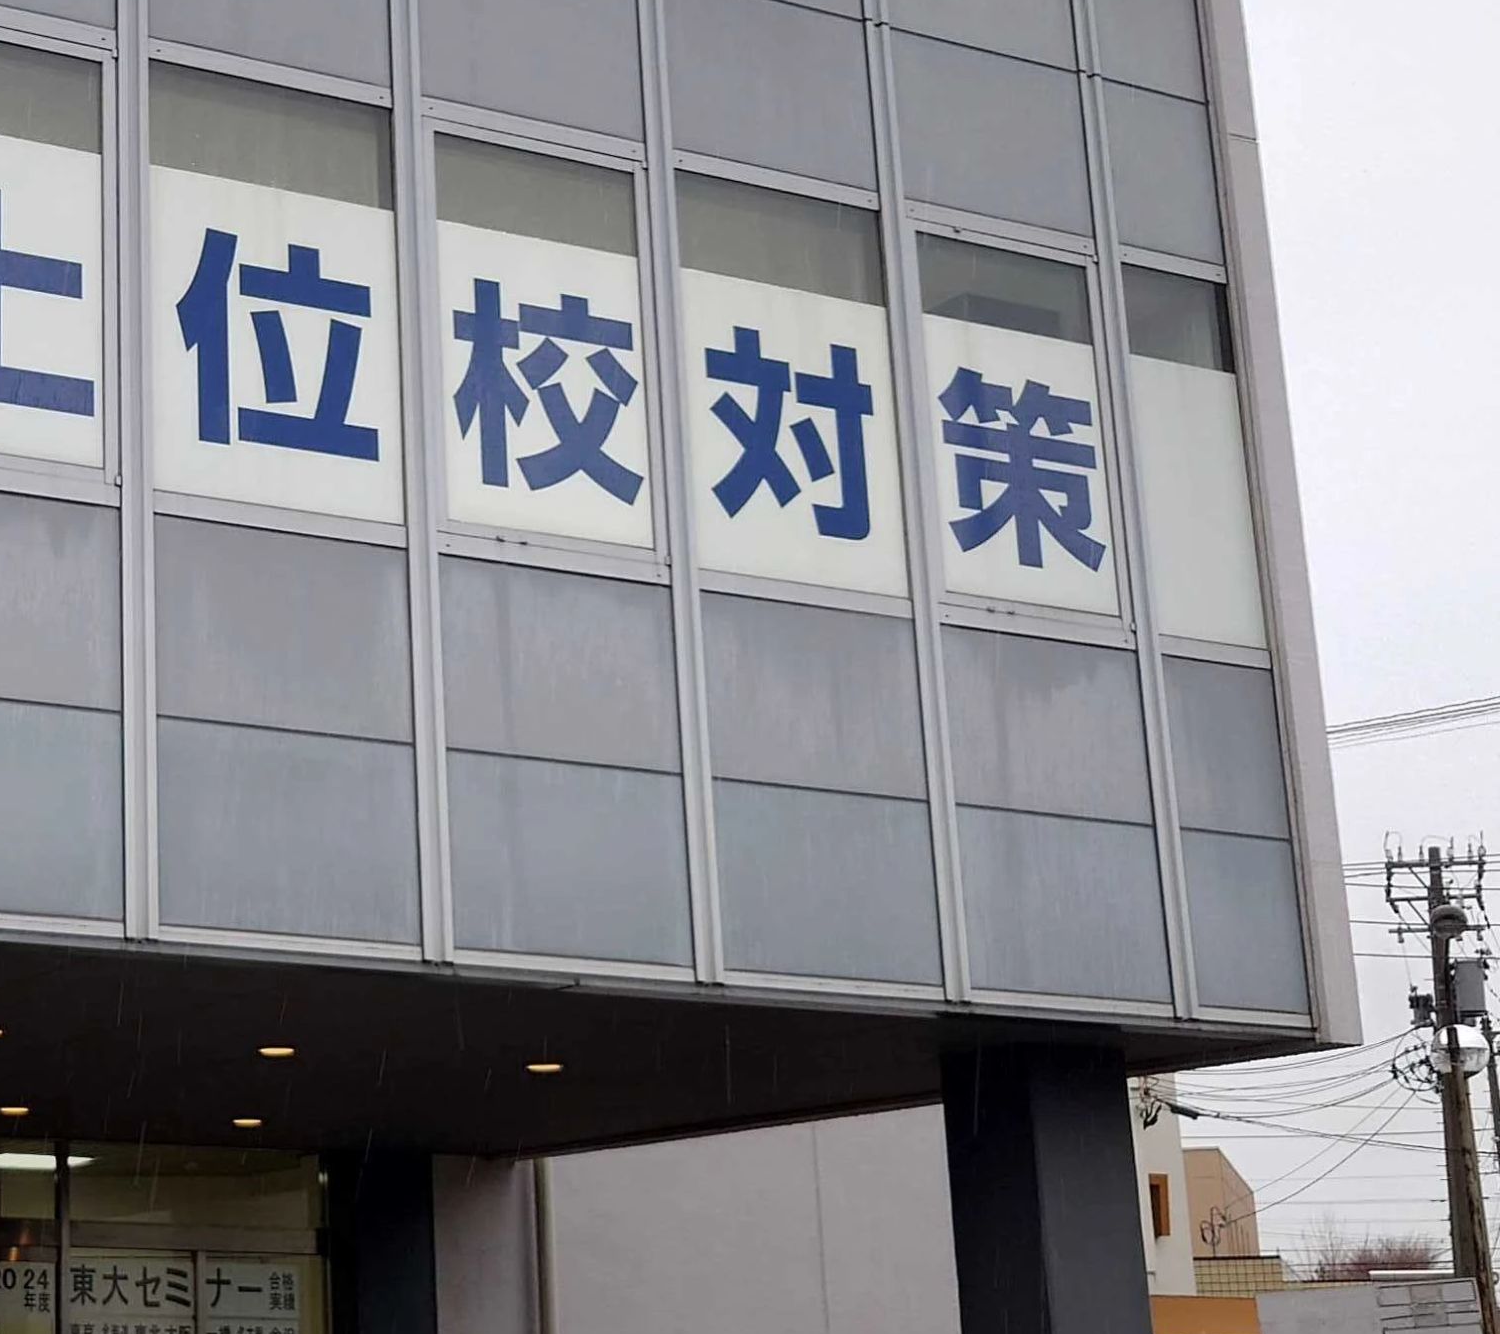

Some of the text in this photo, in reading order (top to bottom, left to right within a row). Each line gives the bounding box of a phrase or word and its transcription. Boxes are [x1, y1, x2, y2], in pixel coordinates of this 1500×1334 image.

[70, 1264, 263, 1308] 東大セミナー
